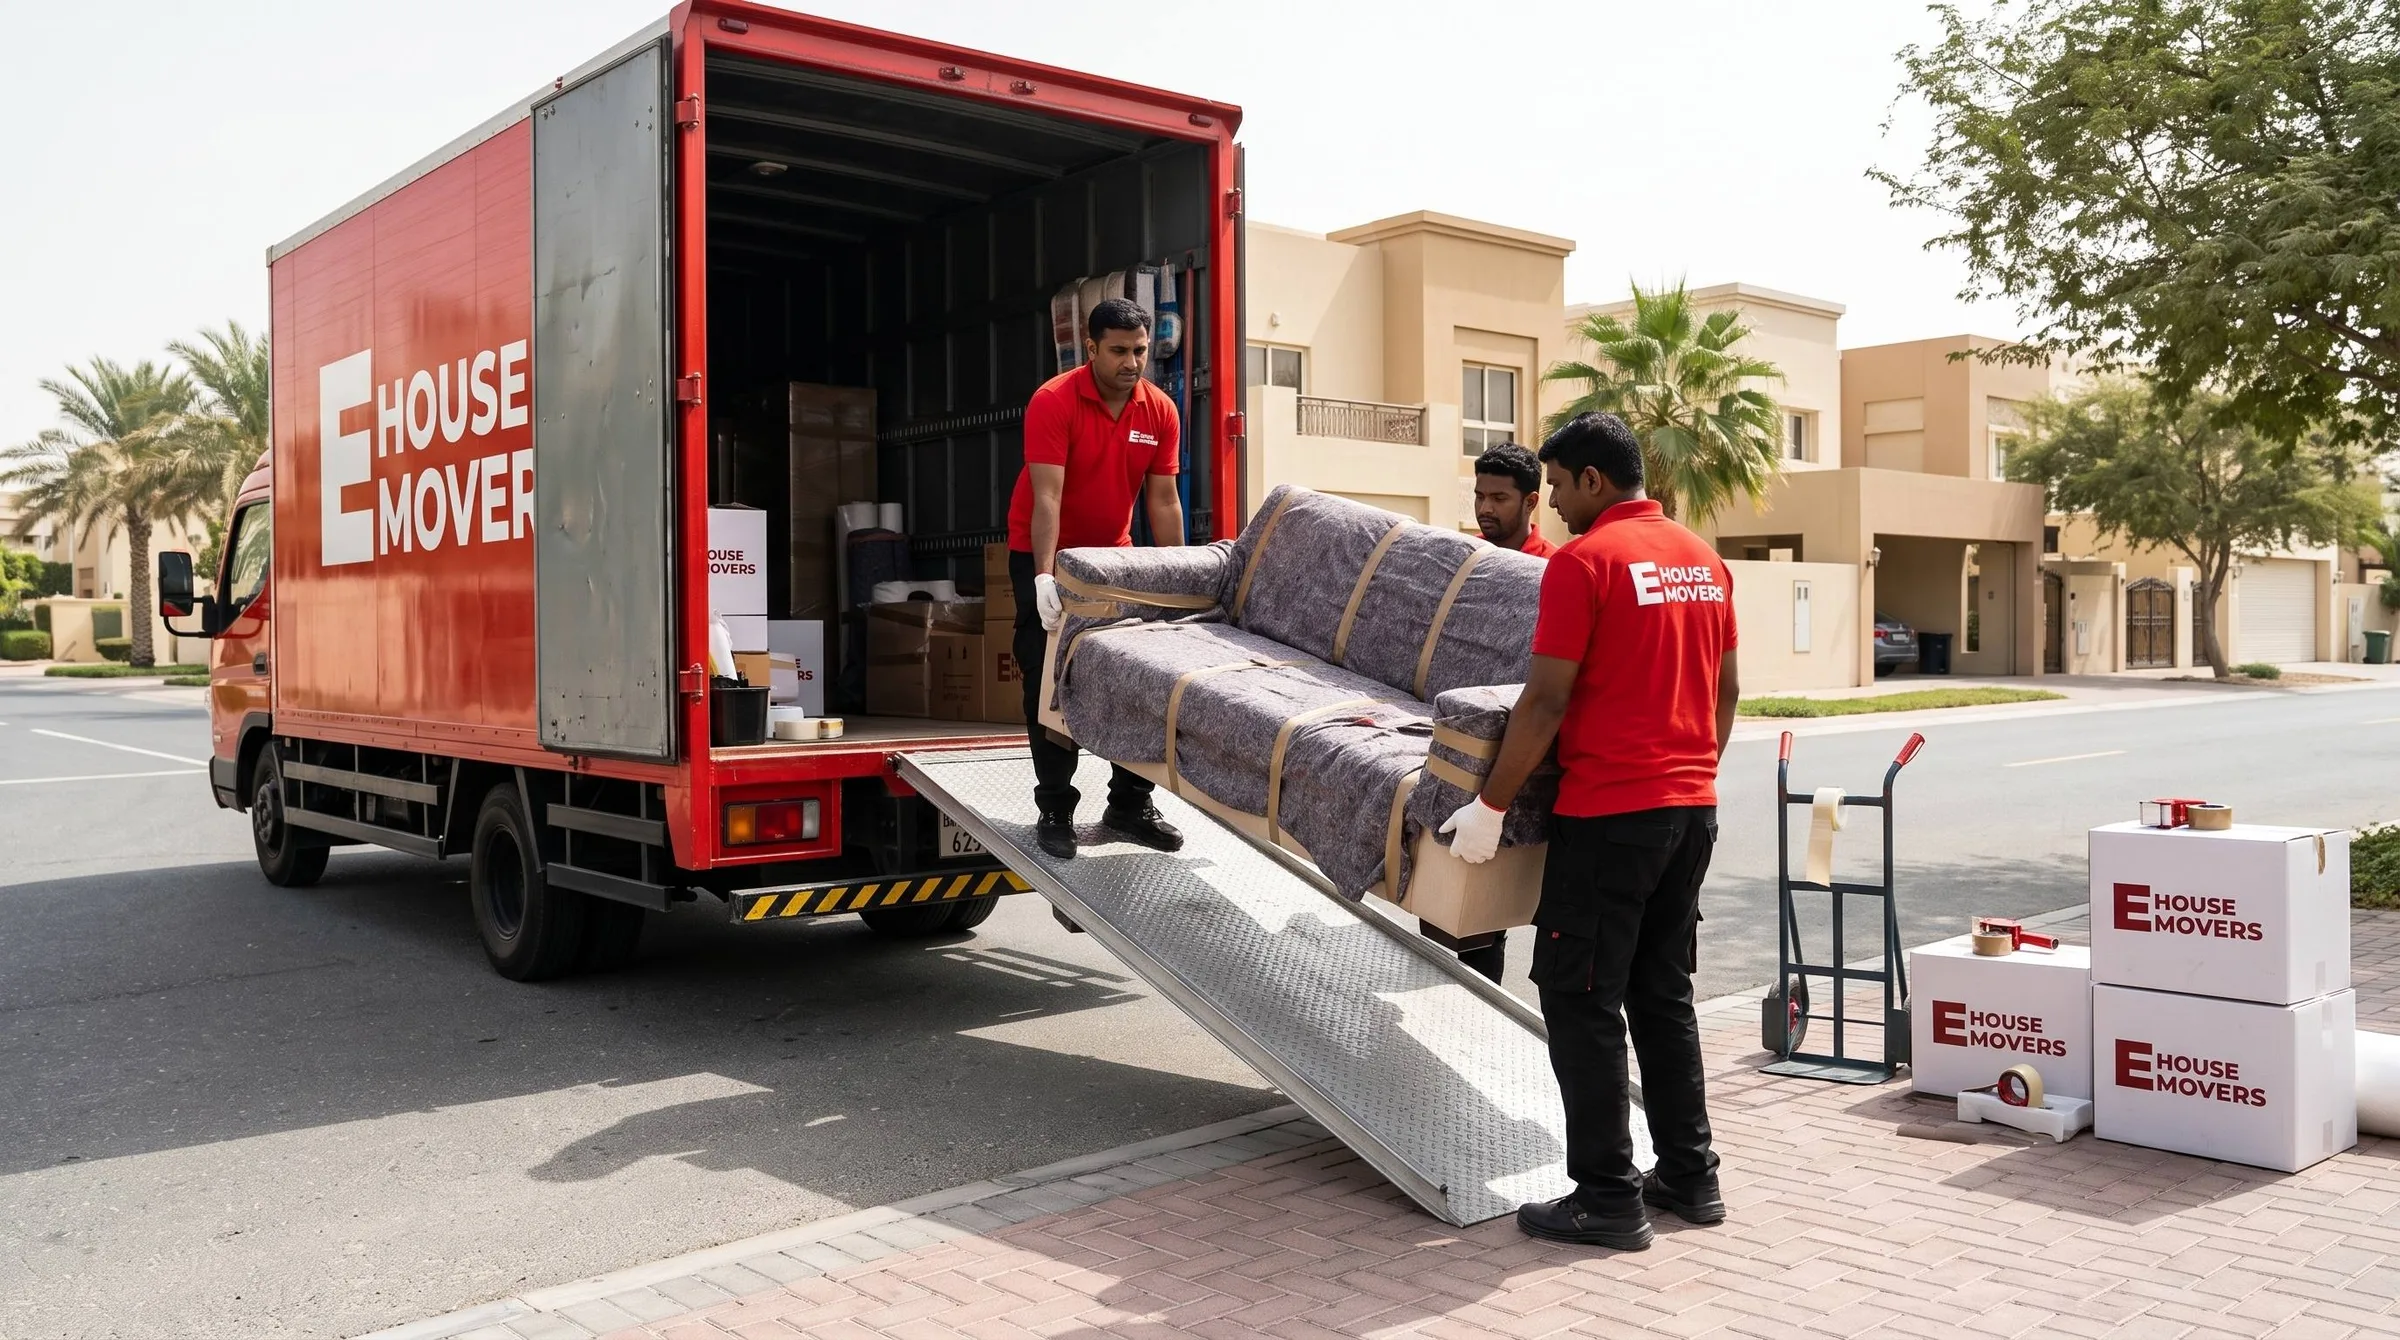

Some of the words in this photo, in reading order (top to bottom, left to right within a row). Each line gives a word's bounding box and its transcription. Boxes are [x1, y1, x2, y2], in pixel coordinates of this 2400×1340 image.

[320, 348, 374, 566] E
[378, 338, 528, 458] HOUSE
[378, 448, 534, 555] MOVER
[707, 550, 744, 561] OUSE
[707, 563, 756, 575] OVERS
[1628, 561, 1665, 606] E
[1660, 566, 1713, 583] HOUSE
[1664, 585, 1724, 603] MOVERS
[2113, 882, 2152, 933] E
[2154, 893, 2236, 916] HOUSE
[2154, 914, 2263, 941] MOVERS
[1932, 1000, 1968, 1047] E
[1970, 1011, 2043, 1033] HOUSE
[1970, 1030, 2067, 1057] MOVERS
[2115, 1038, 2154, 1091] E
[2156, 1053, 2239, 1081] HOUSE
[2156, 1074, 2267, 1107] MOVERS
